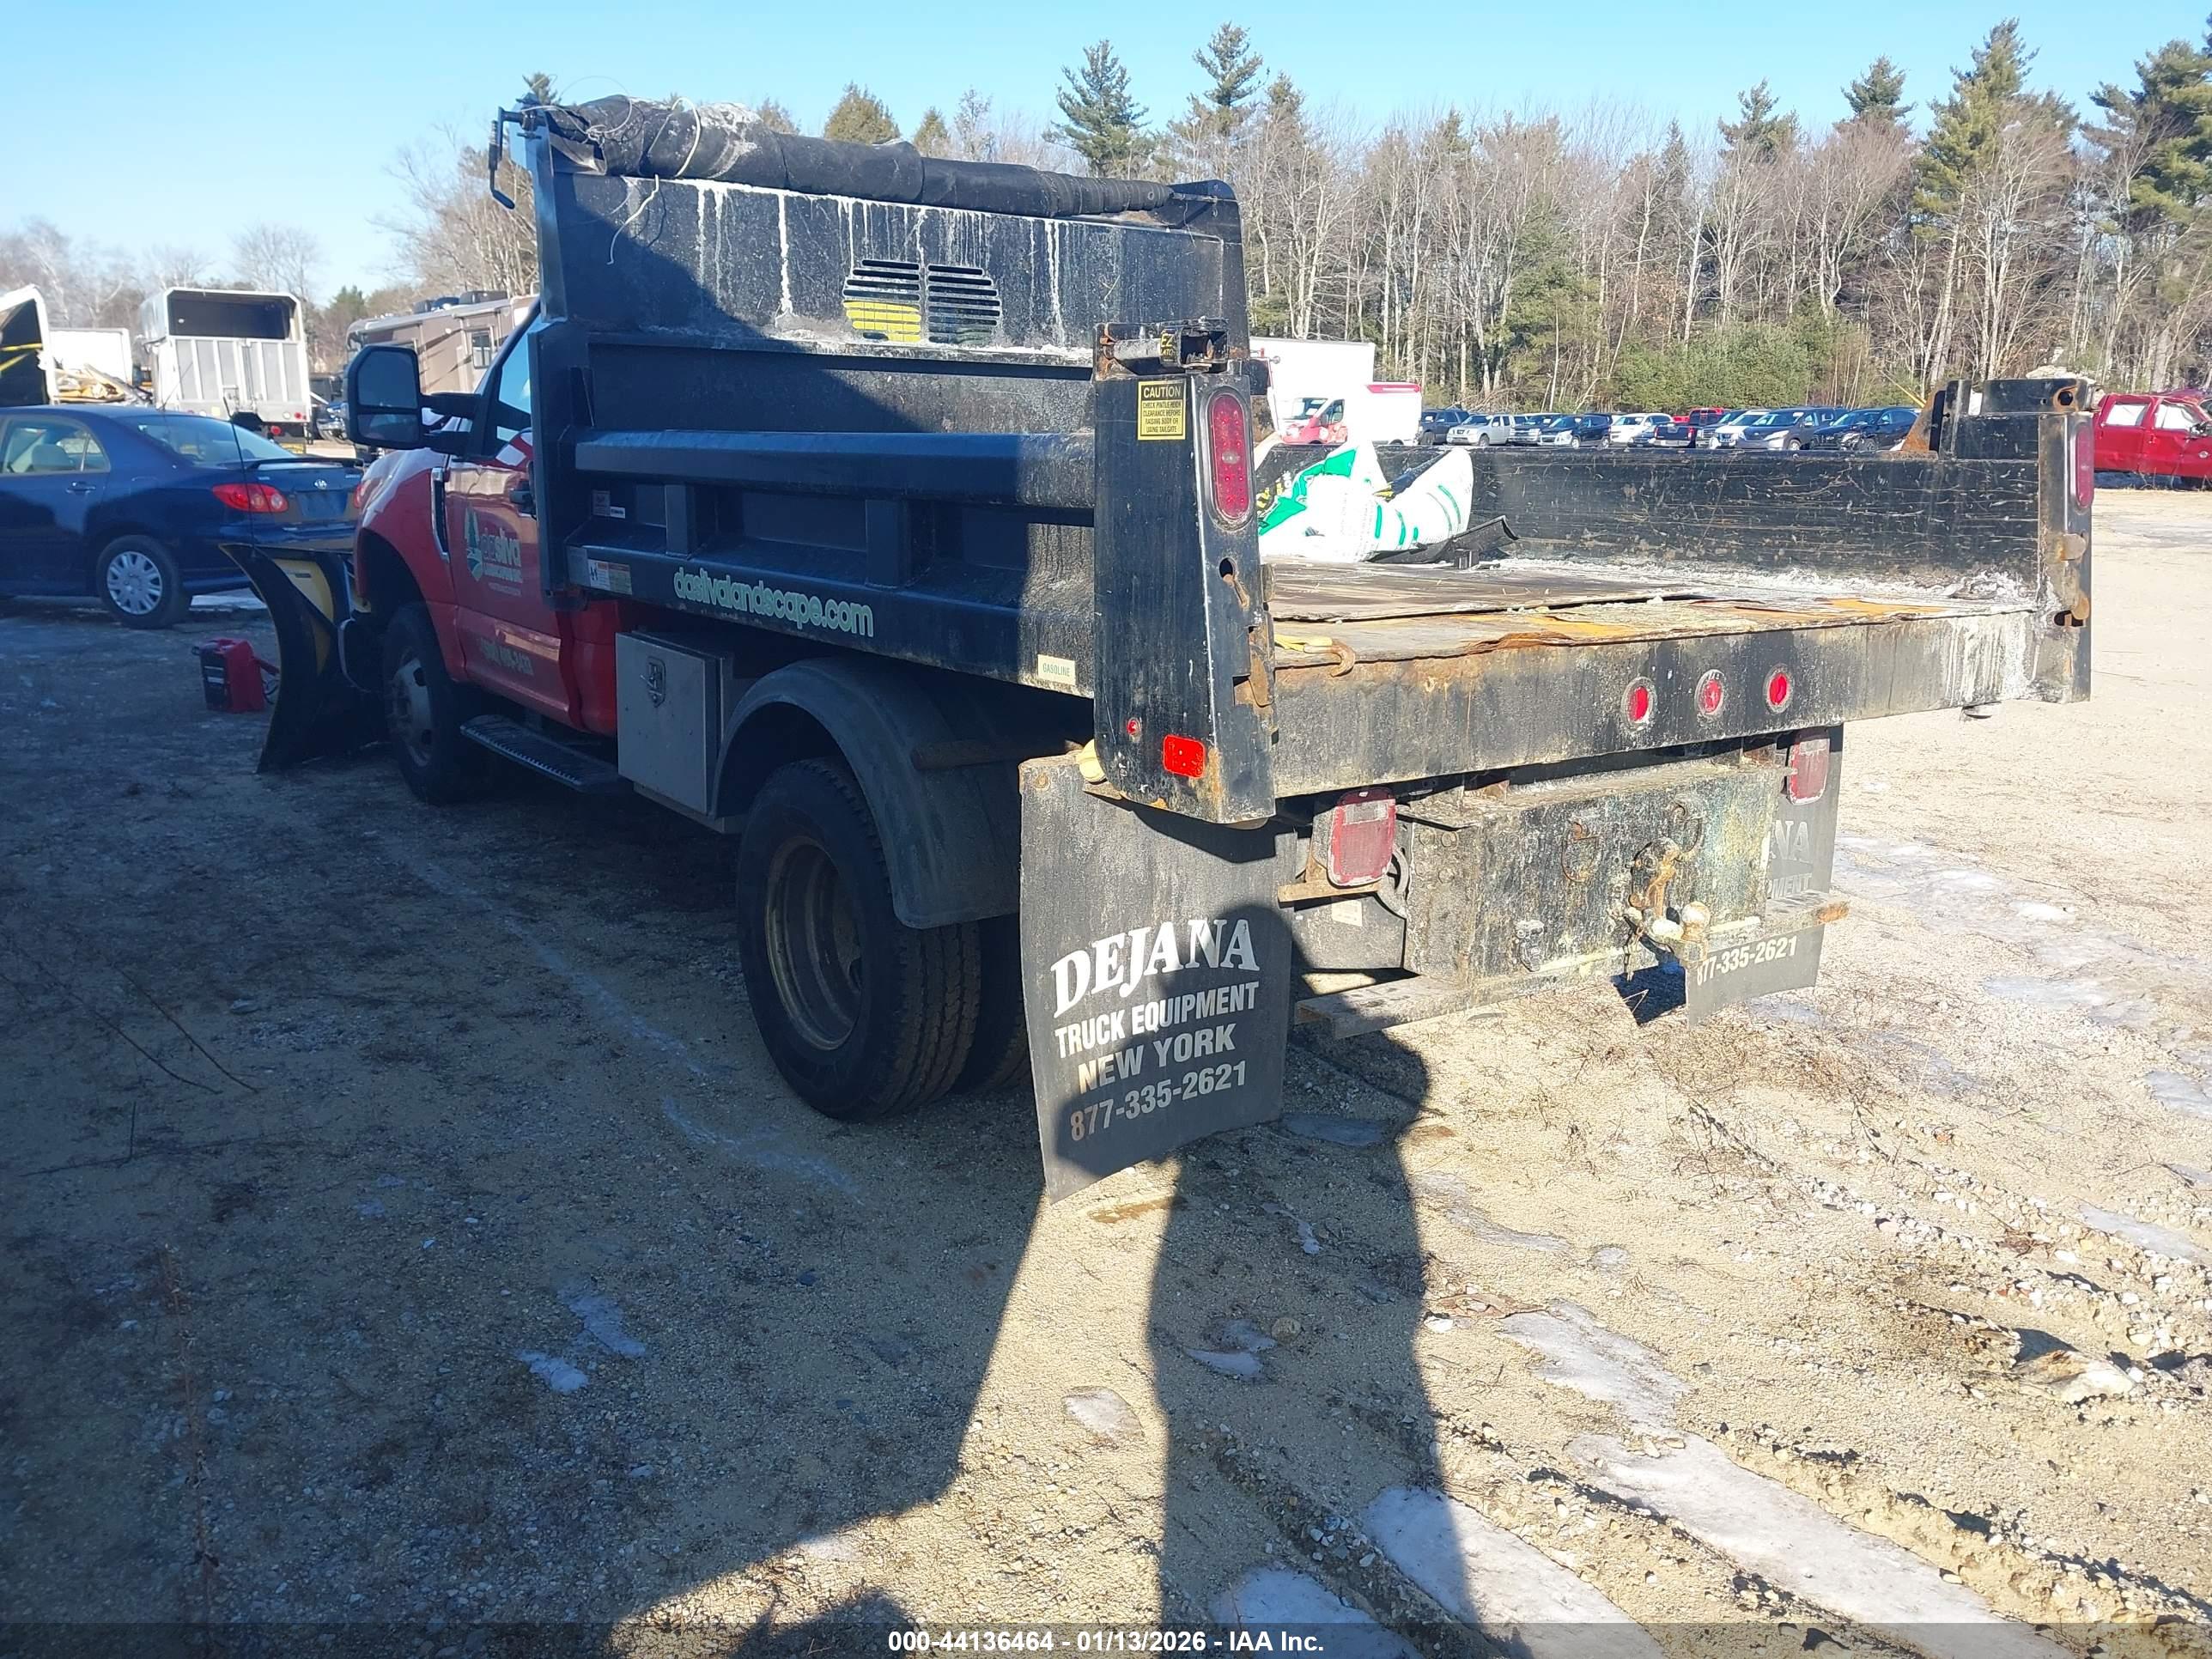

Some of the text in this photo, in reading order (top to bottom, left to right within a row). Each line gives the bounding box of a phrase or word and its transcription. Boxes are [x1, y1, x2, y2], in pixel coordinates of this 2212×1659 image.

[1161, 333, 1174, 347] EZ
[1143, 386, 1182, 398] CAUTION
[673, 567, 874, 637] dasilvalandscape.com
[1042, 663, 1070, 677] GASOLINE
[1050, 919, 1261, 1018] DEJANA
[1054, 981, 1260, 1059] TRUCK EQUIPMENT
[1078, 1023, 1237, 1095] NEW YORK
[1070, 1060, 1247, 1142] 877-335-2621
